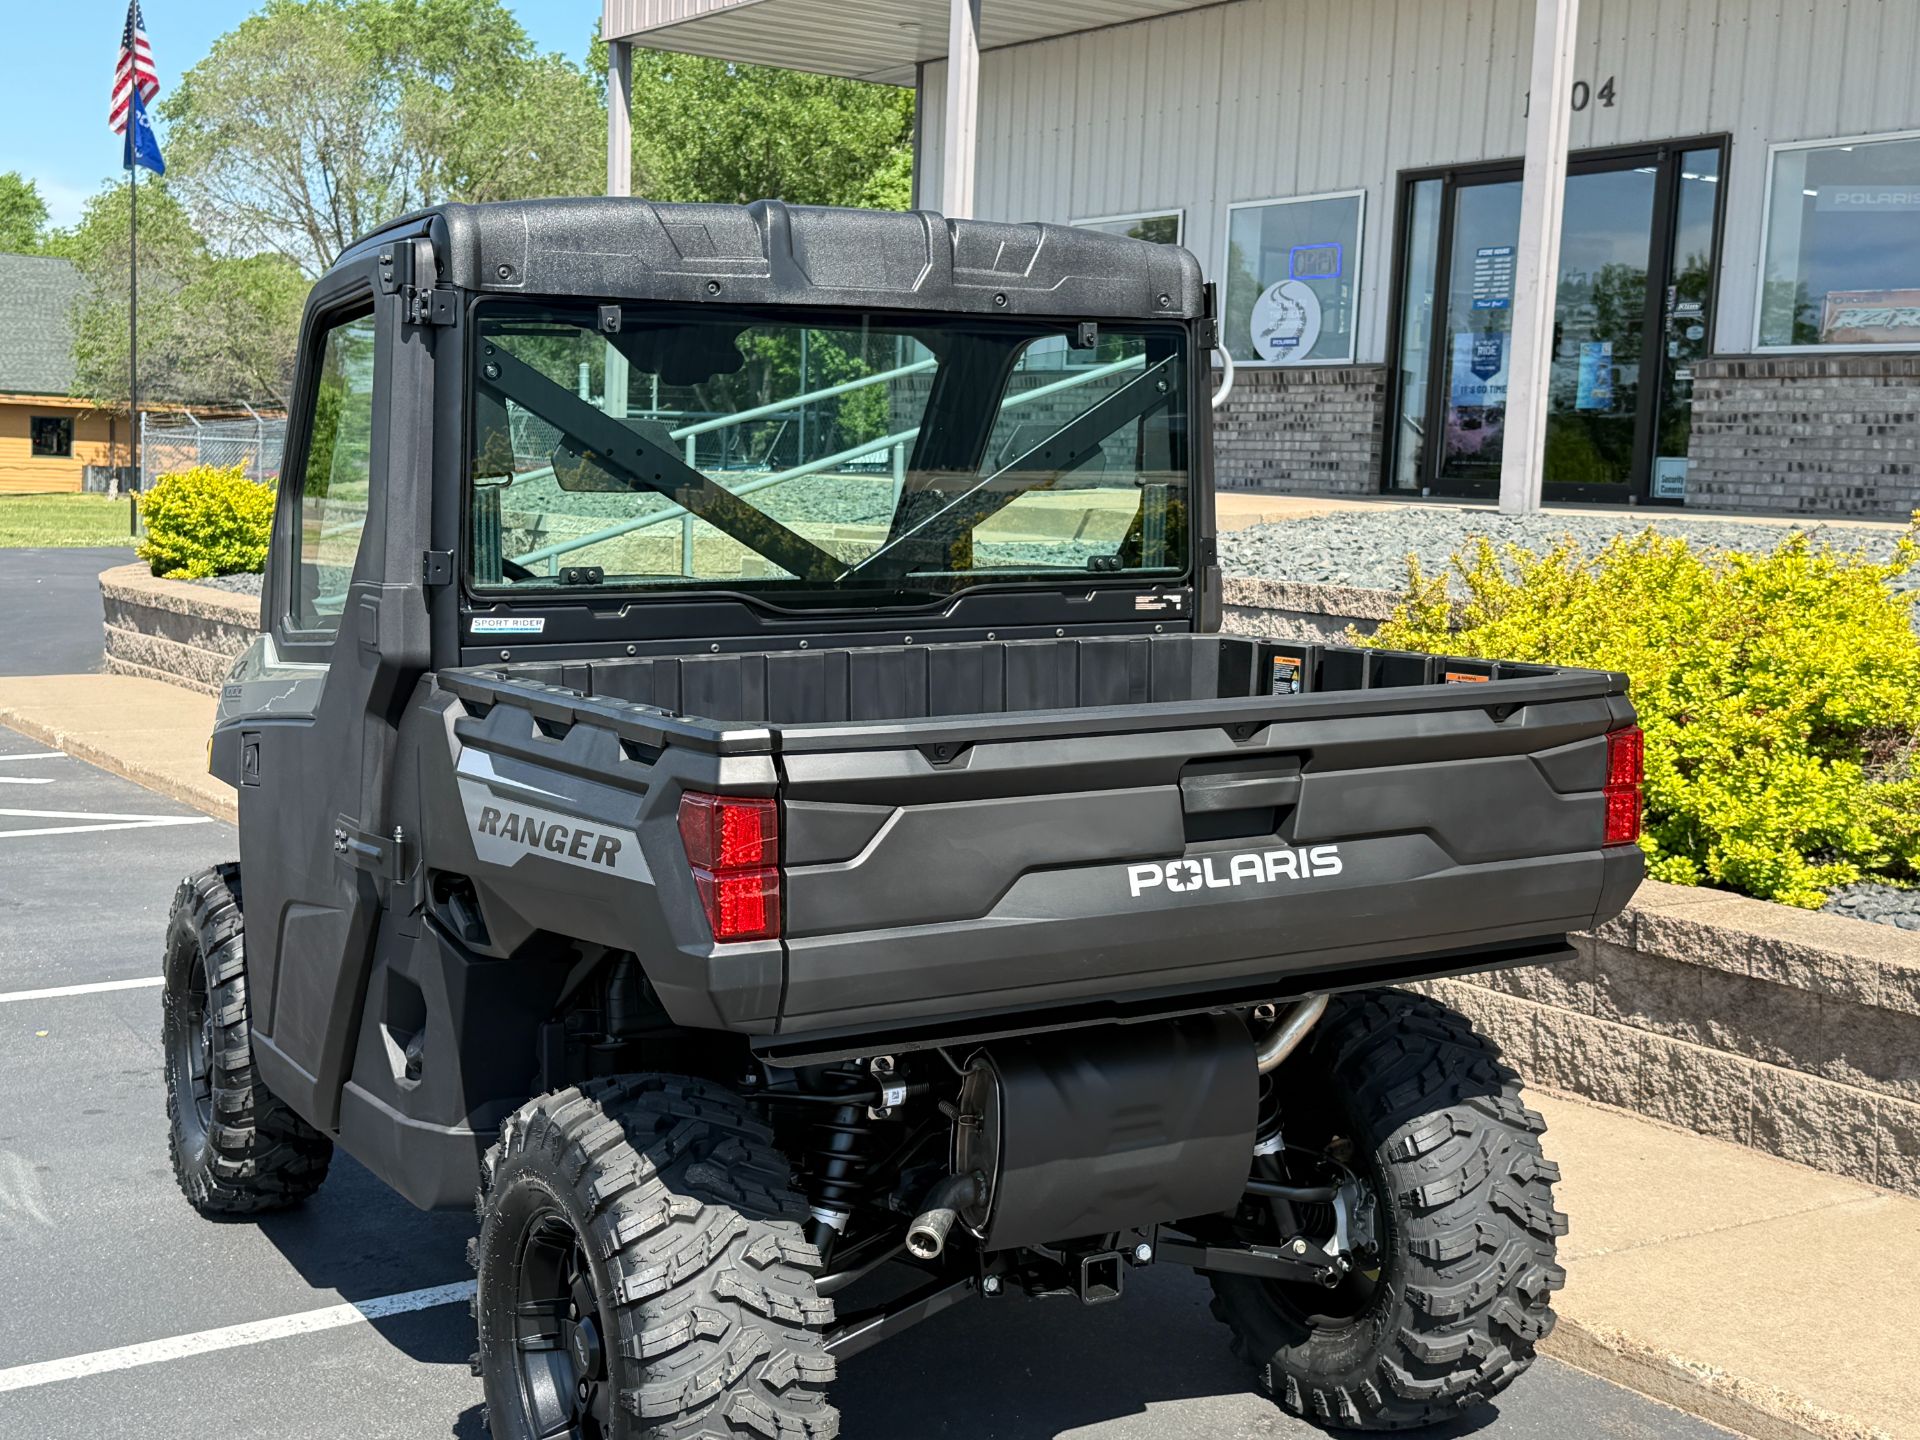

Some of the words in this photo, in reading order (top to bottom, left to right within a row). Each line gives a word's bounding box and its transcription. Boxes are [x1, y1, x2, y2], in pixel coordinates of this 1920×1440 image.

[1476, 385, 1487, 394] GO
[1661, 474, 1684, 485] Security
[474, 619, 509, 627] SPORT
[512, 619, 543, 627] RIDER
[477, 806, 622, 868] RANGER
[1127, 845, 1343, 898] POLARIS
